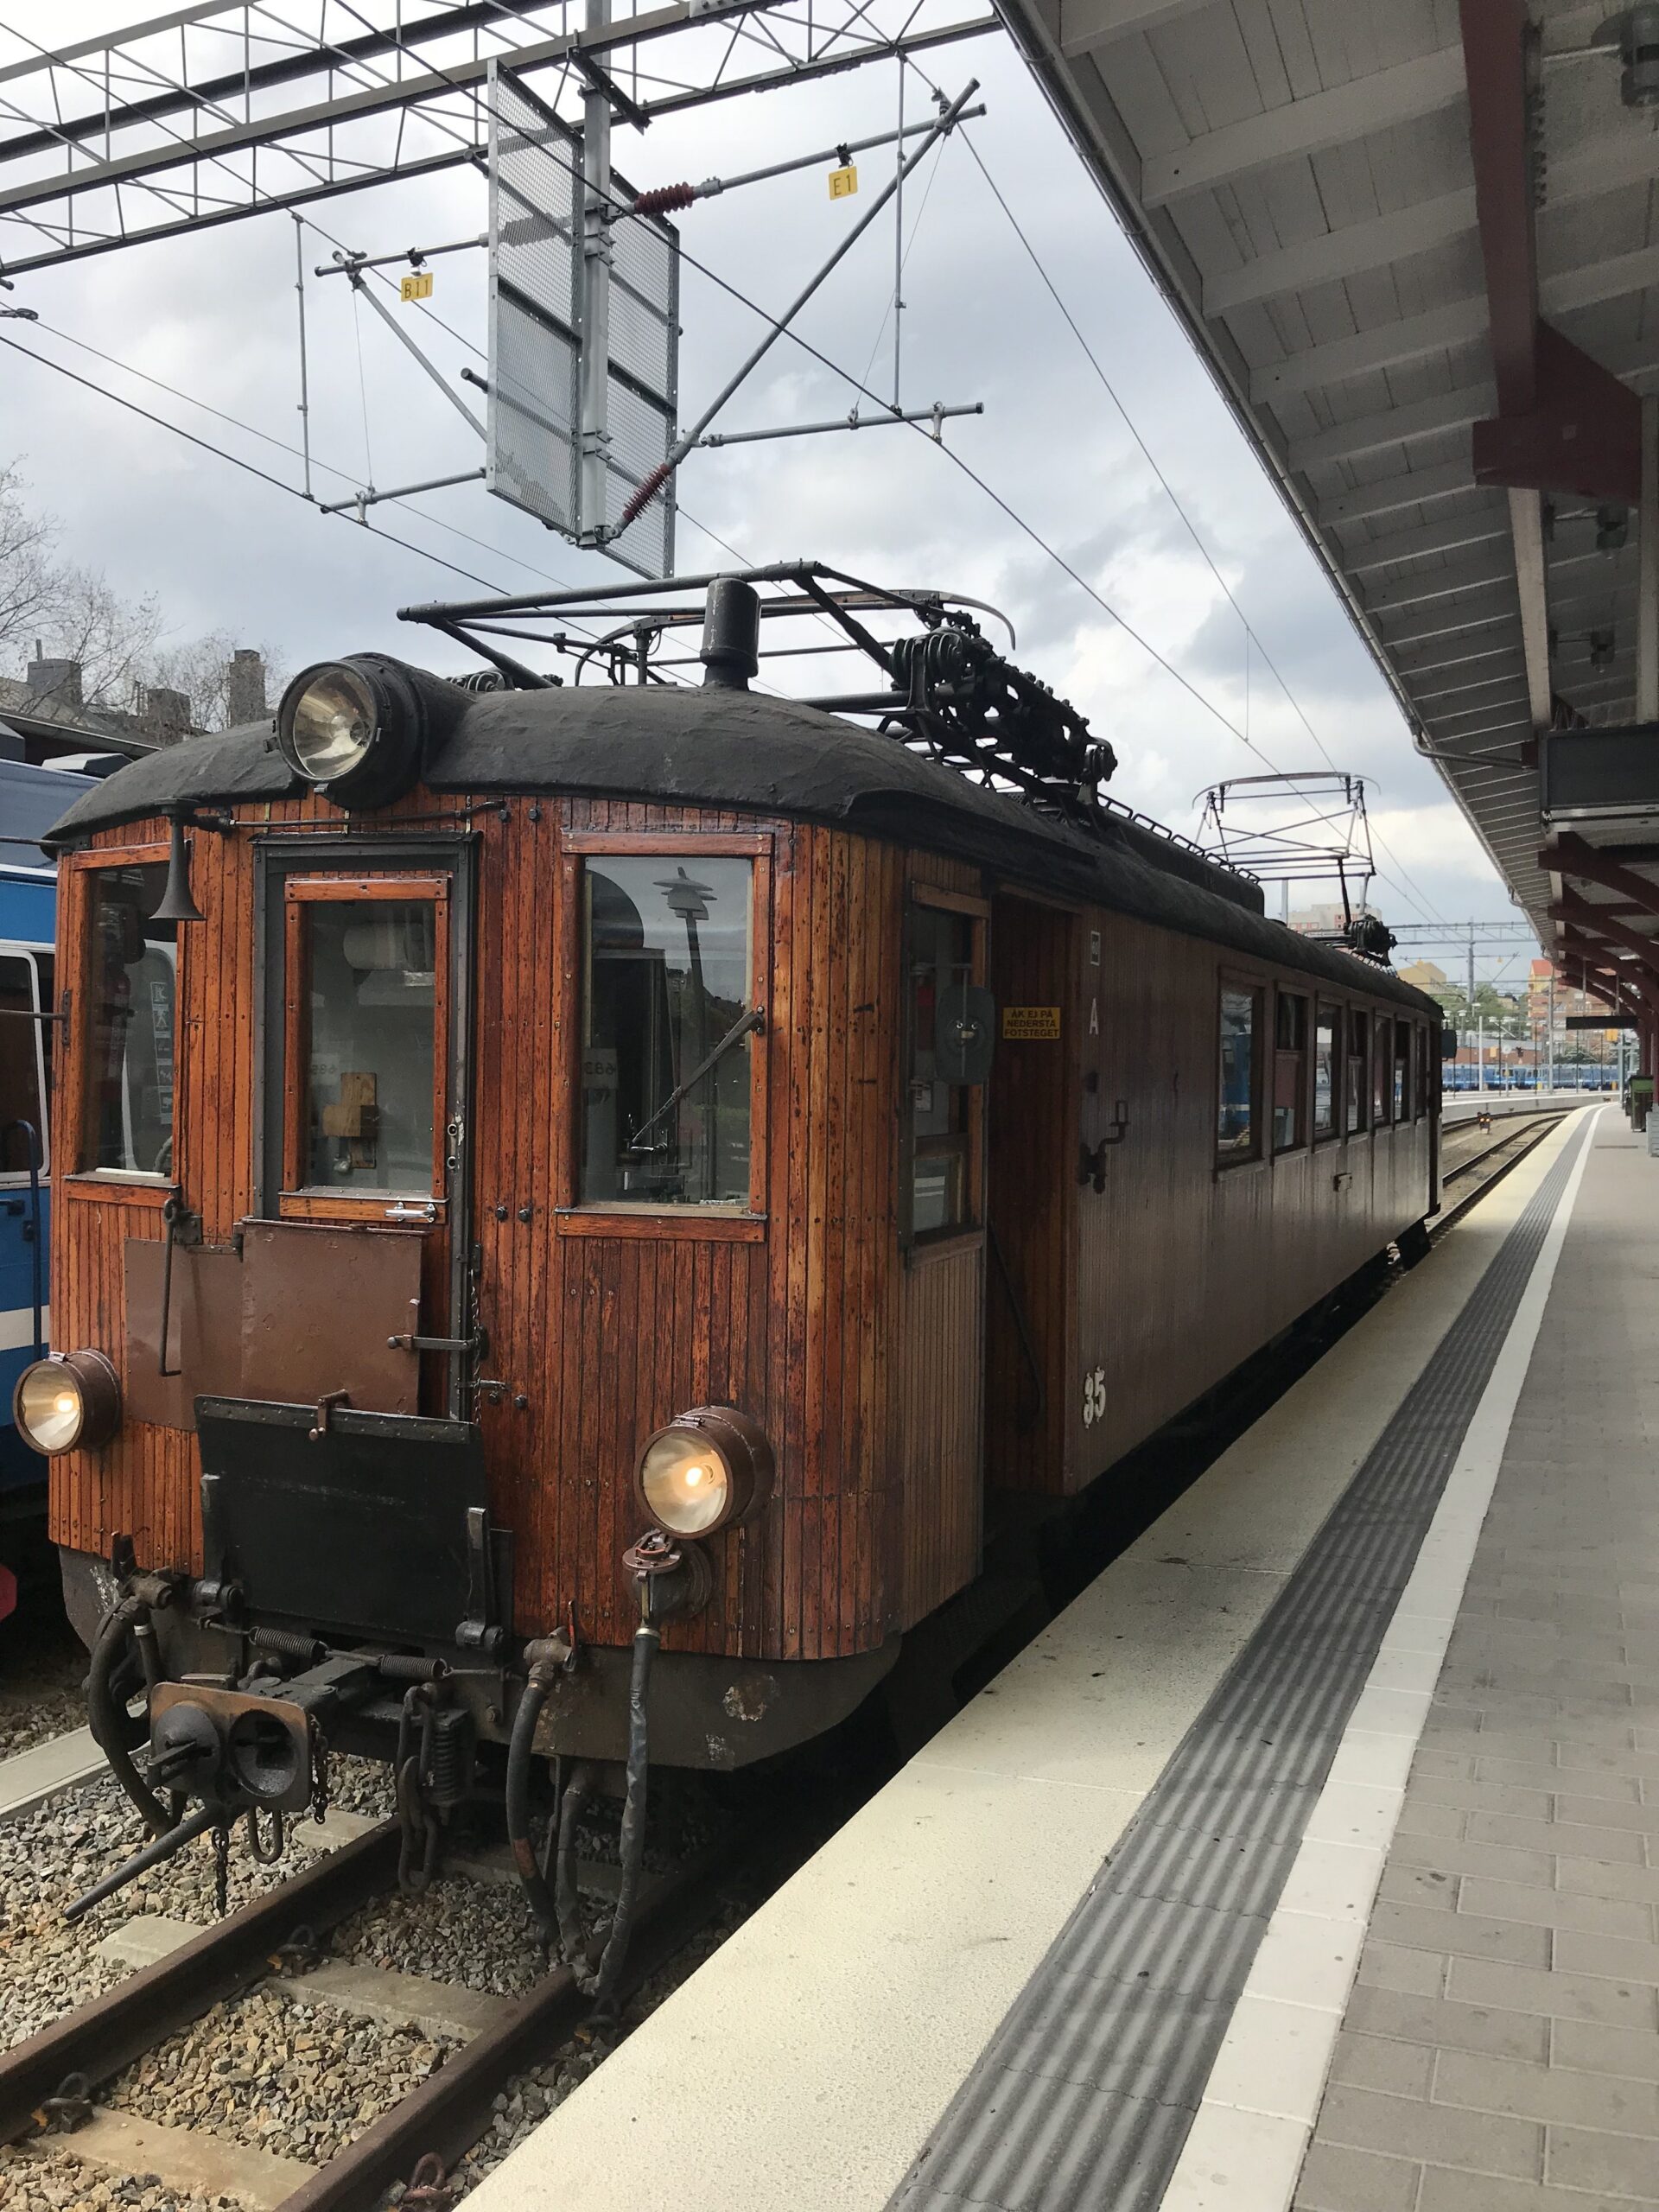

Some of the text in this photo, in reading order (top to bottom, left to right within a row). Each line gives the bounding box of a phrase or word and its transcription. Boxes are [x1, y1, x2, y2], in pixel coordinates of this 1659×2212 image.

[833, 174, 851, 196] E1
[404, 278, 429, 299] B11
[1089, 997, 1099, 1035] A
[1004, 1028, 1059, 1037] FOTSTEGET
